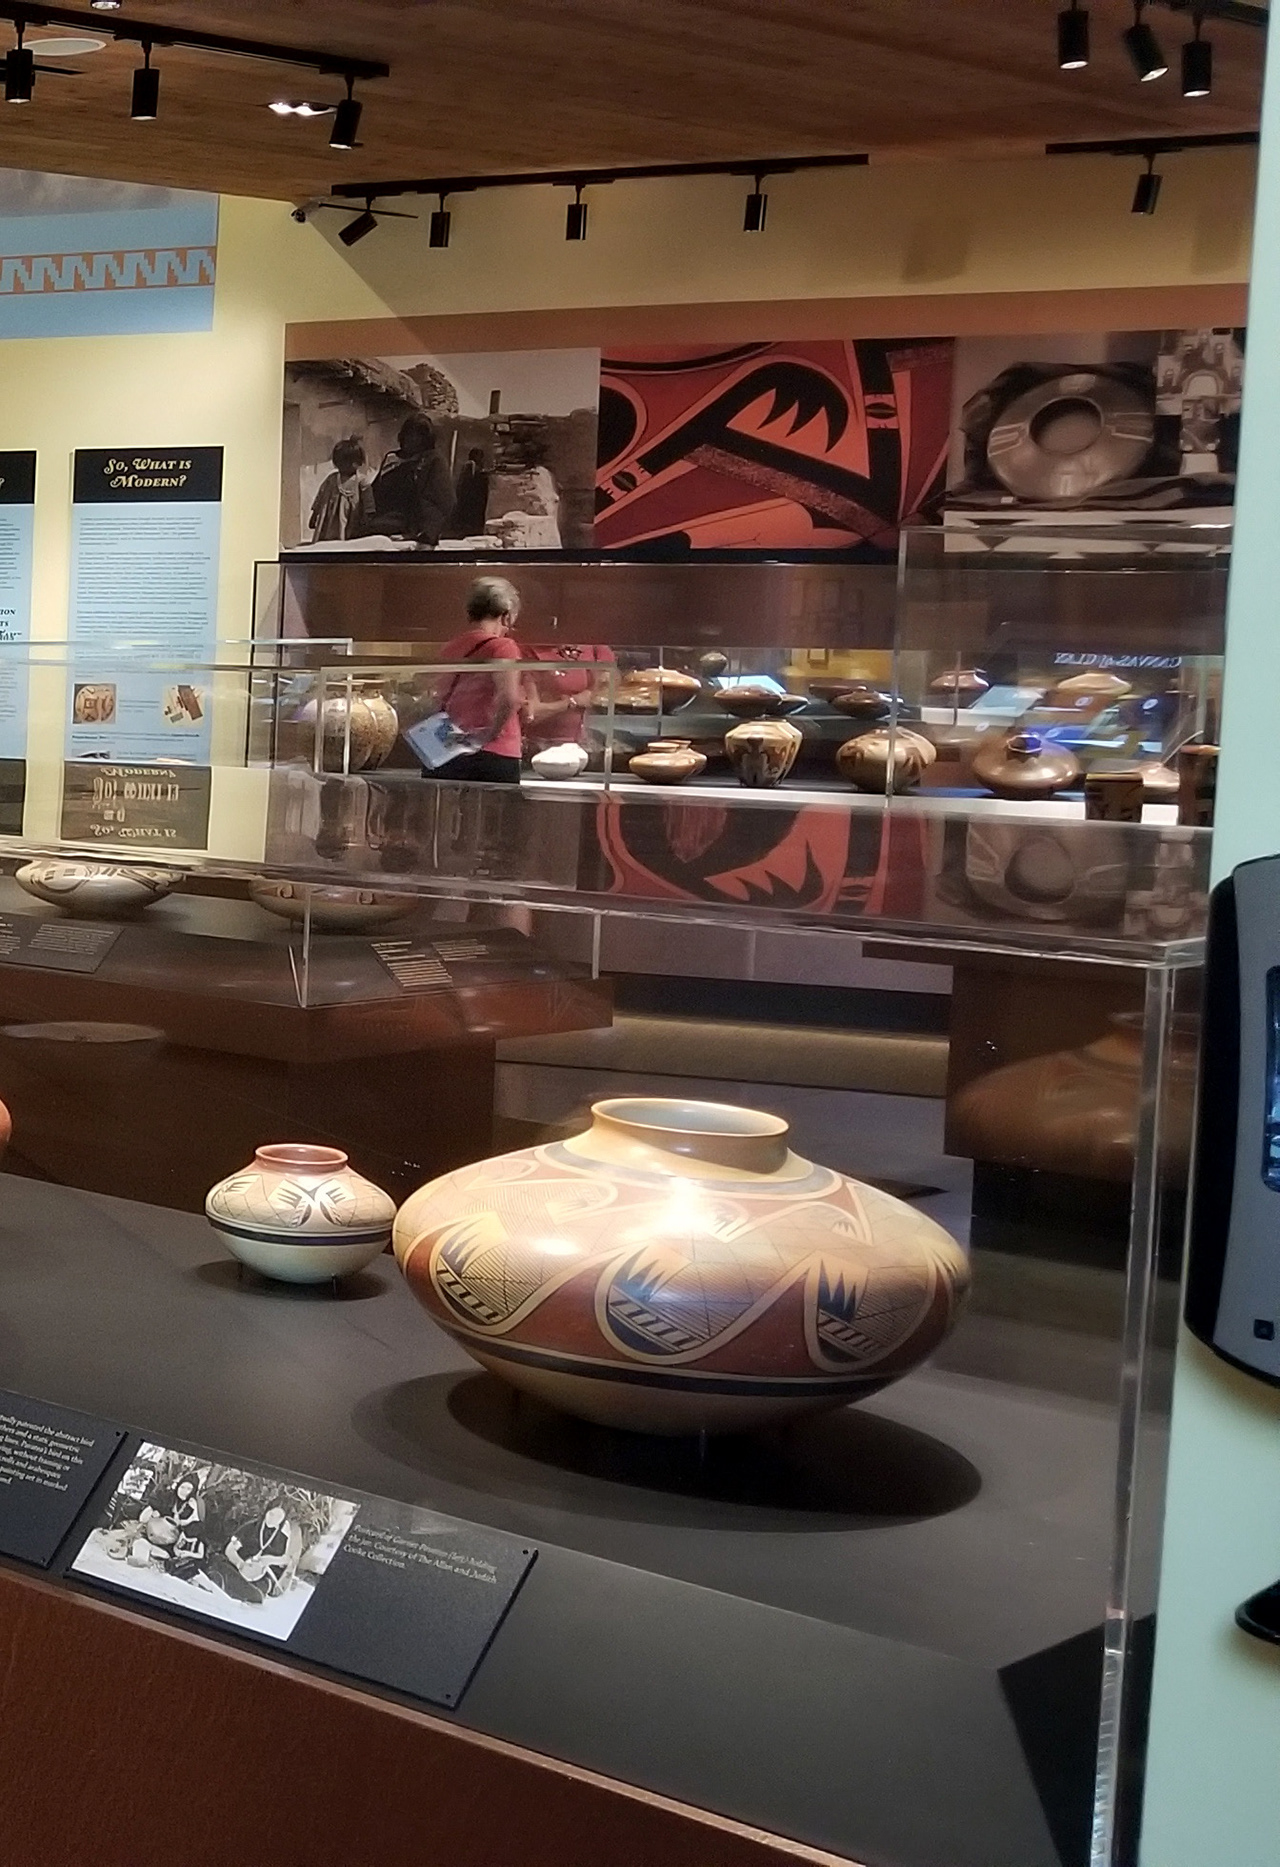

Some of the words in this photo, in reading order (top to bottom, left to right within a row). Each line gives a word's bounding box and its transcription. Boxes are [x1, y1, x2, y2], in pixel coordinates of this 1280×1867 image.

[103, 458, 129, 475] SO,
[132, 457, 177, 470] WHAT
[179, 459, 192, 470] IS
[109, 474, 187, 489] MODERN?
[44, 1427, 55, 1435] the
